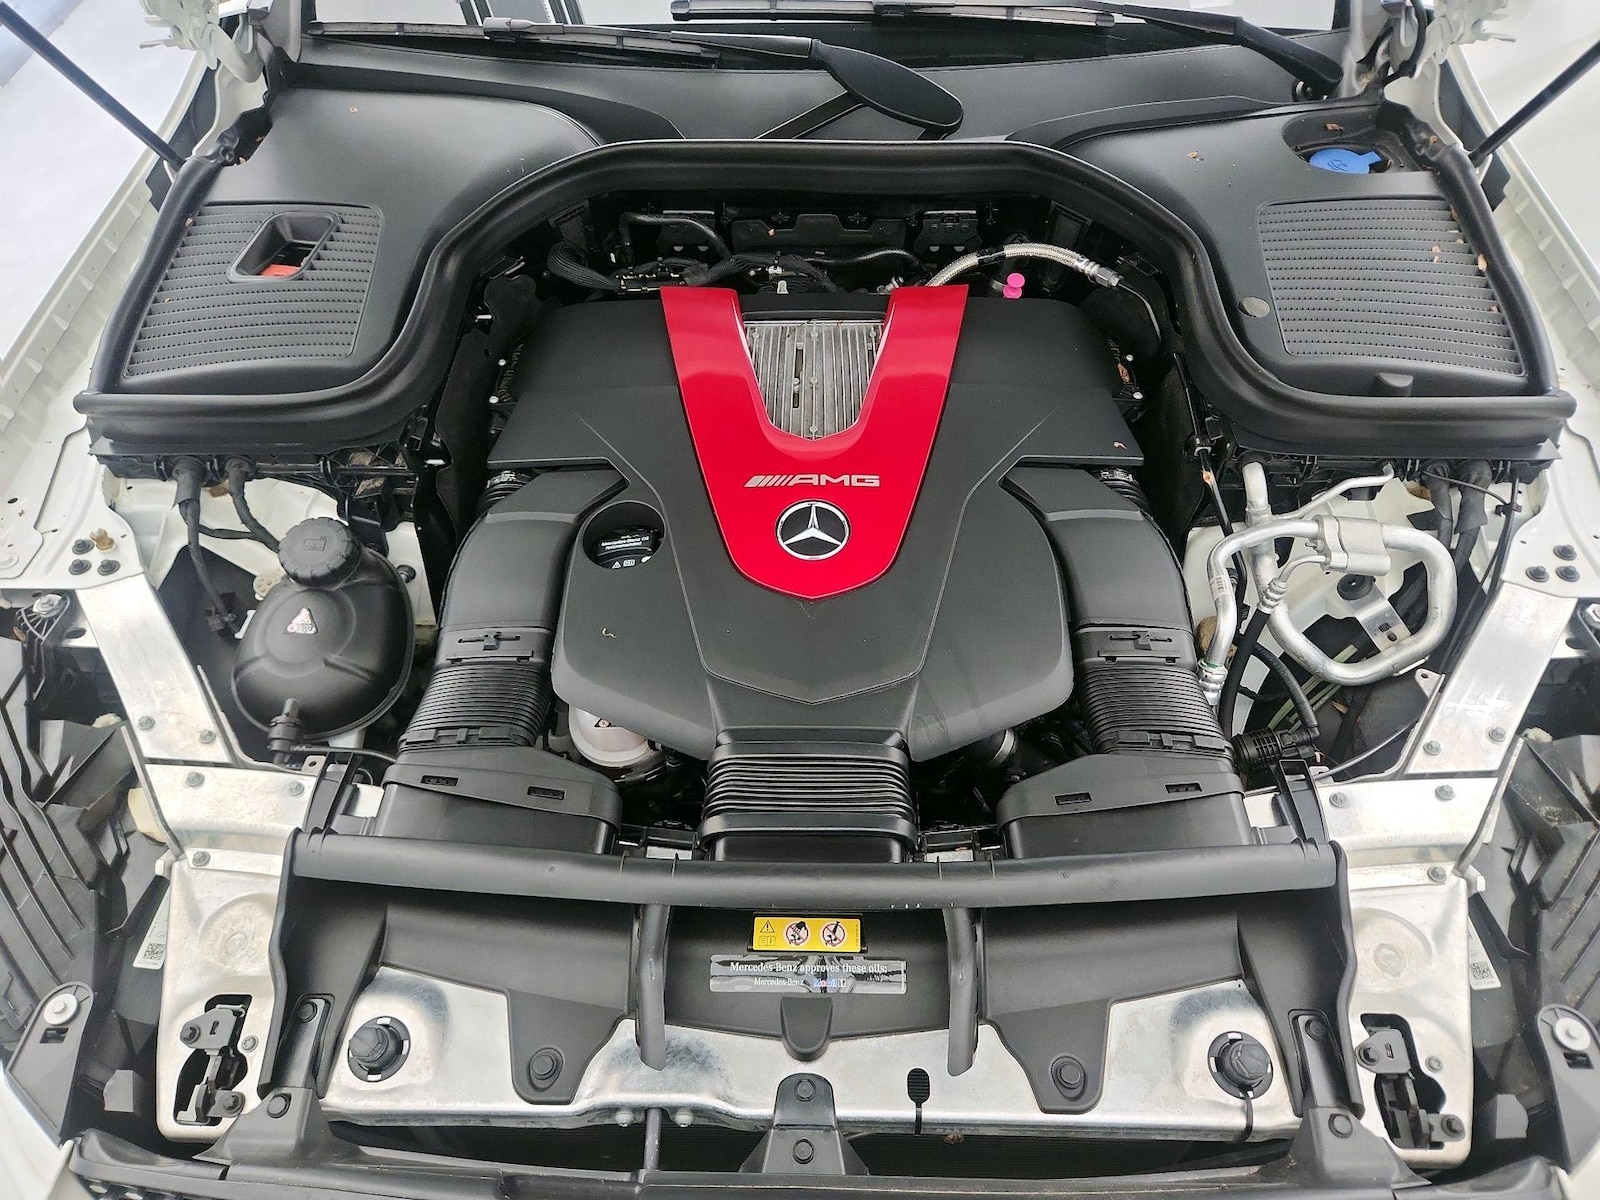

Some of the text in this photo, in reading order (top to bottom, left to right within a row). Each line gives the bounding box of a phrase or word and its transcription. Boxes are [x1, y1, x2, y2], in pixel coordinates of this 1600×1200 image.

[730, 962, 798, 972] Mercedes-Benz
[799, 965, 840, 975] approves
[842, 962, 867, 973] these
[754, 977, 804, 986] Mercedes-Benz
[813, 978, 838, 988] Mobil
